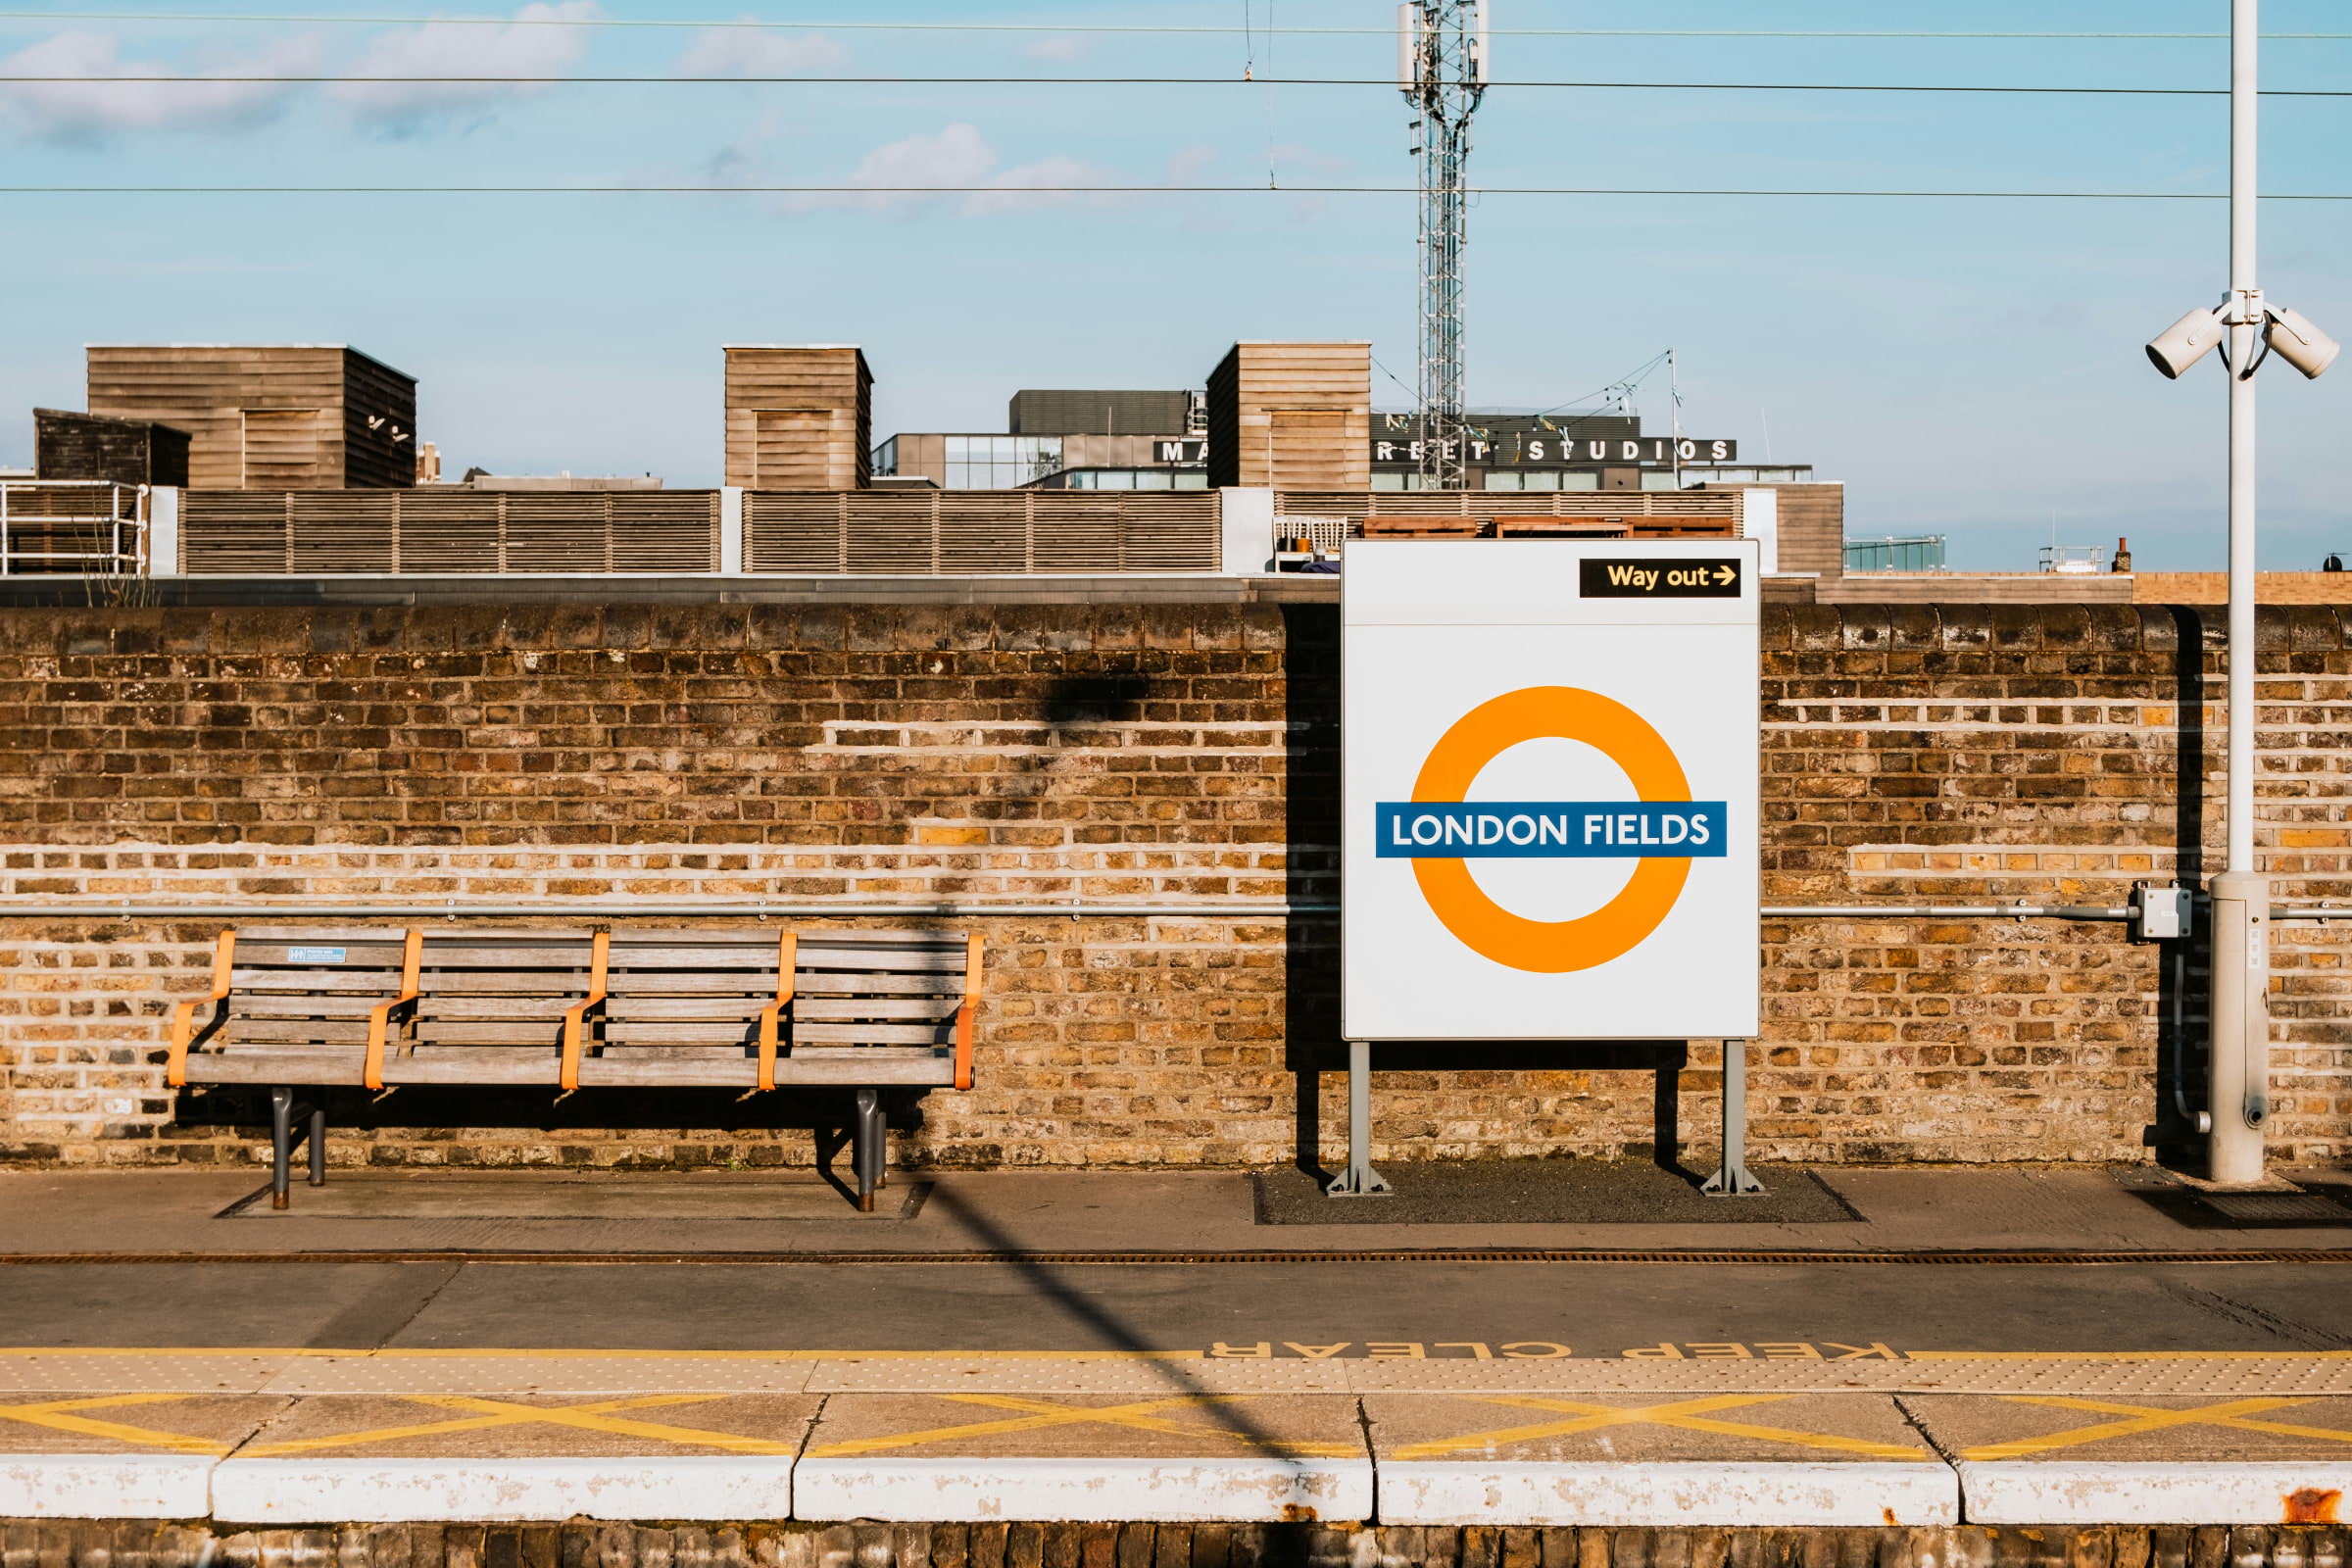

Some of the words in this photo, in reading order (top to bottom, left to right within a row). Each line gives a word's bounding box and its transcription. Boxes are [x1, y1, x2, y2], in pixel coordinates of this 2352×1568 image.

[1529, 440, 1728, 460] STUDIOS
[1607, 565, 1659, 591] Way
[1667, 567, 1710, 586] out
[1393, 814, 1568, 846] LONDON
[1584, 813, 1710, 846] FIELDS
[1210, 1342, 1572, 1359] CLEAR
[1621, 1343, 1899, 1359] KEEP
